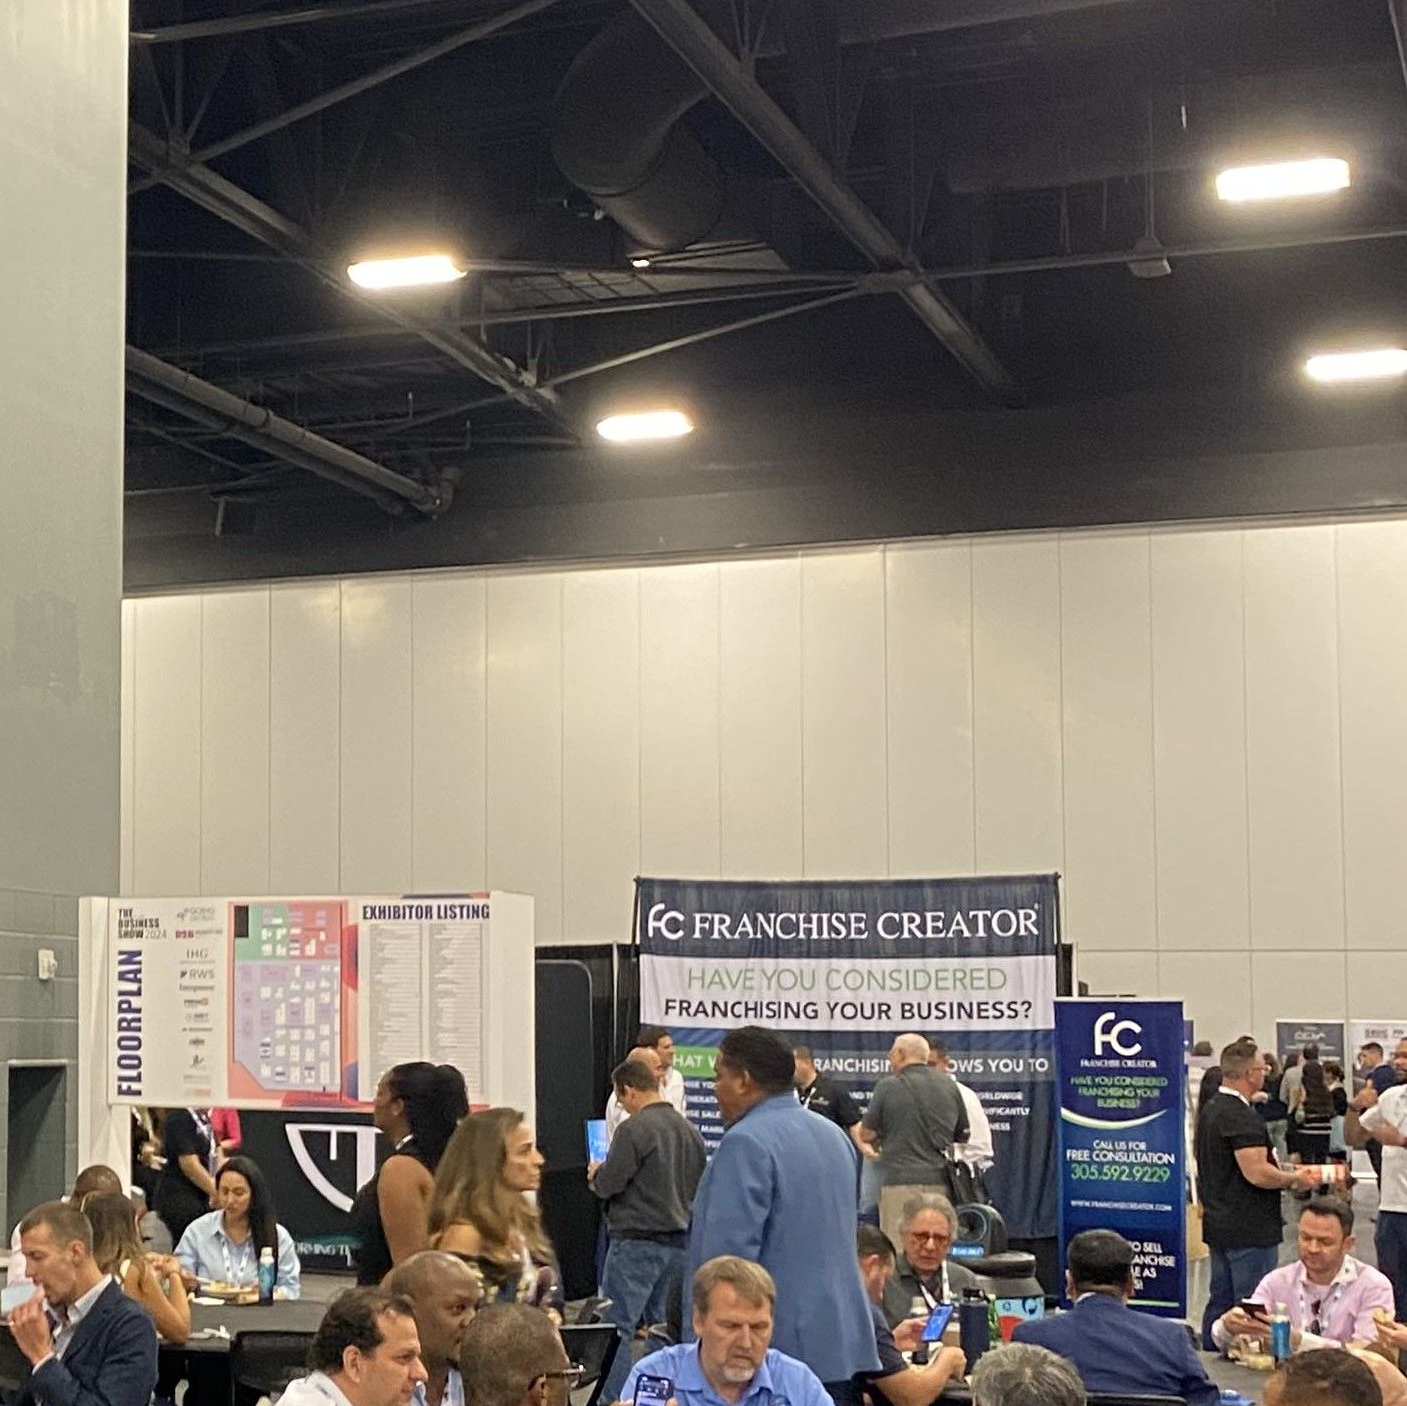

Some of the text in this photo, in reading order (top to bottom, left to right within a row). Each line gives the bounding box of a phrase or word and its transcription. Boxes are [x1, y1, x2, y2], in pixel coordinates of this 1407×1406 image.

[118, 908, 133, 918] THE
[362, 904, 490, 920] EXHIBITOR LISTING
[118, 918, 160, 928] BUSINESS
[692, 912, 868, 940] FRANCHISE
[876, 909, 1039, 939] CREATOR
[118, 928, 144, 939] SHOW
[145, 929, 167, 939] 2024
[688, 967, 1007, 992] HAVE YOU CONSIDERED
[664, 998, 1032, 1020] FRANCHISING YOUR BUSINESS?
[117, 950, 142, 1096] FLOORPLAN
[673, 1055, 703, 1068] HAT
[814, 1058, 1049, 1073] RANCHISIN OWS YOU TO
[1093, 1140, 1147, 1151] CALL US FOR
[1067, 1149, 1176, 1165] FREE CONSULTATION
[1071, 1164, 1171, 1183] 305.592.9229
[1143, 1241, 1163, 1254] SELL
[1133, 1255, 1176, 1267] ANCHISE
[1143, 1269, 1157, 1279] AS
